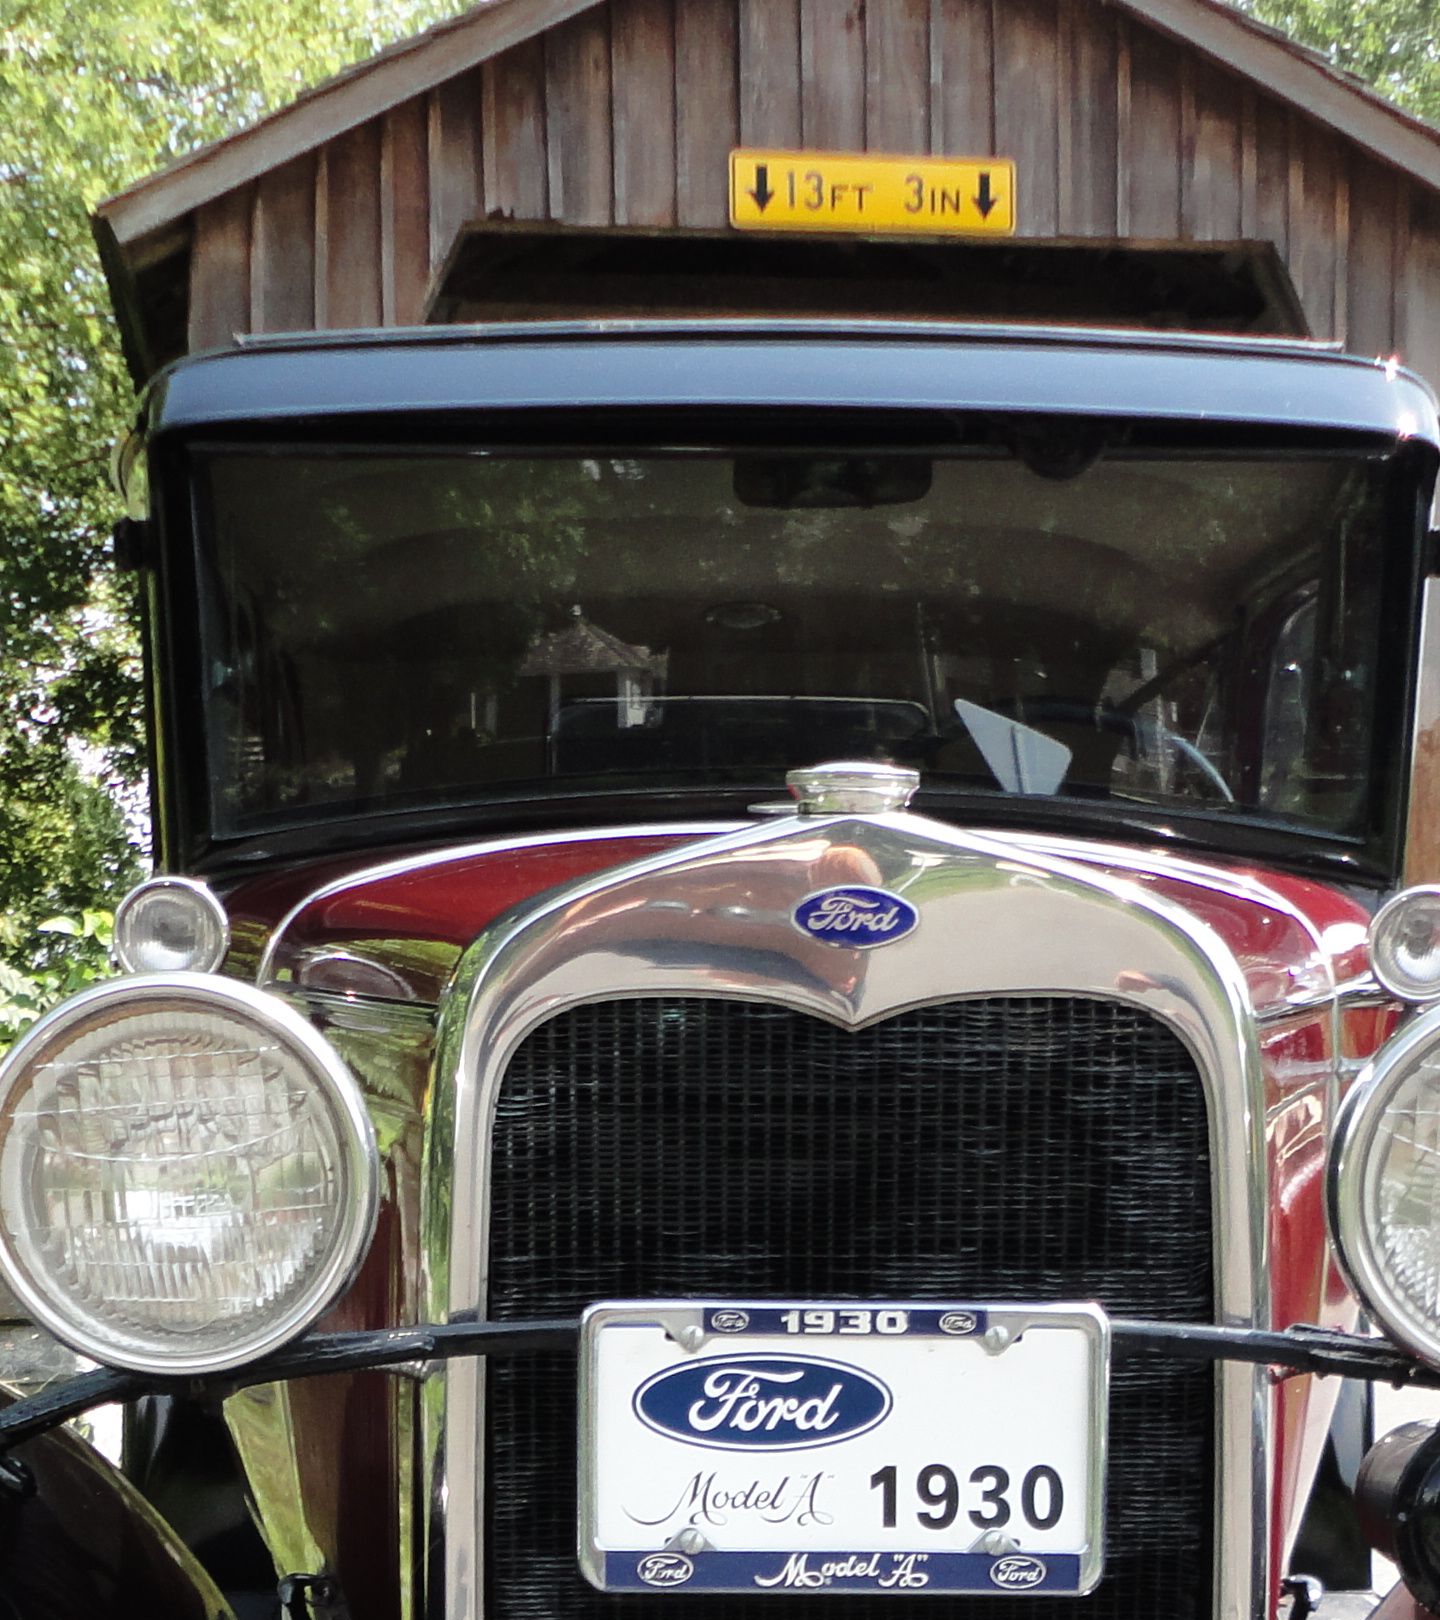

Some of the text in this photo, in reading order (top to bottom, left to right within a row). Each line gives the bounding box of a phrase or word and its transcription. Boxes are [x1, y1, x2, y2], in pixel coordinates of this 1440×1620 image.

[904, 174, 961, 216] 3IN
[807, 896, 901, 932] Ford
[780, 1310, 910, 1335] 1930
[688, 1369, 843, 1432] Ford
[620, 1471, 791, 1527] Model
[870, 1464, 1064, 1531] 1930
[753, 1553, 929, 1588] Model "A"
